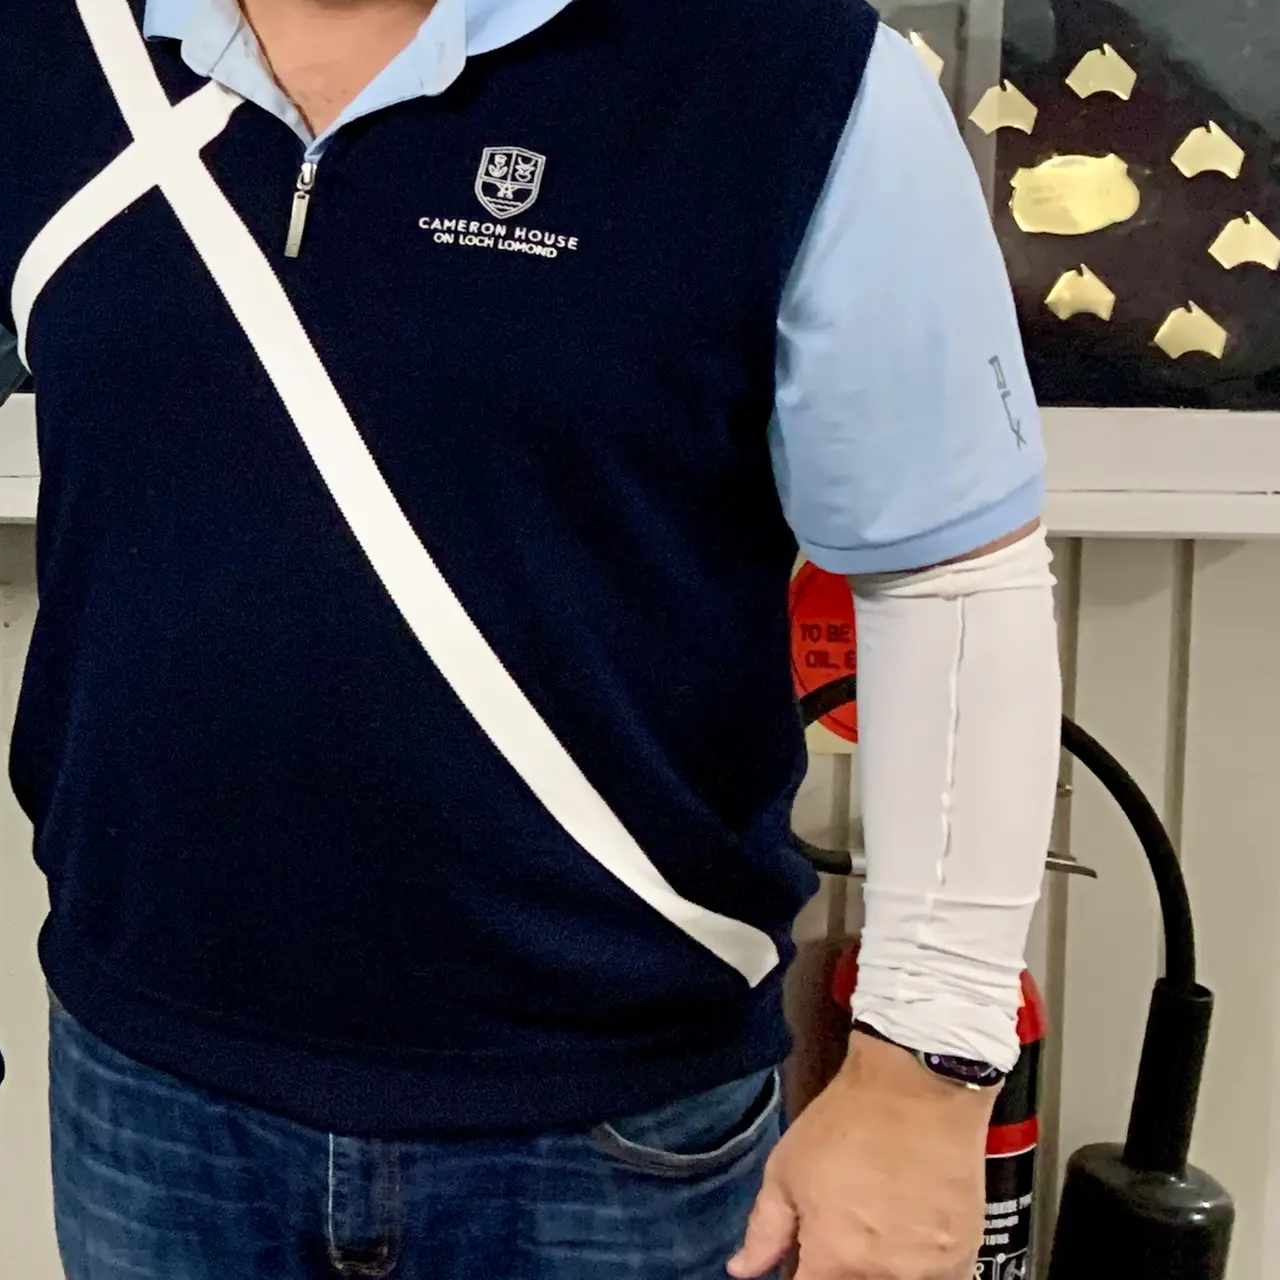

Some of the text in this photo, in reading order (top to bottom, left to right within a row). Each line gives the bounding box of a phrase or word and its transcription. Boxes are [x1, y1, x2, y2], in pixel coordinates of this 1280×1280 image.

[418, 217, 579, 250] CAMERON HOUSE
[433, 232, 558, 258] ON LOCH LOMOND
[800, 624, 851, 643] TO BE
